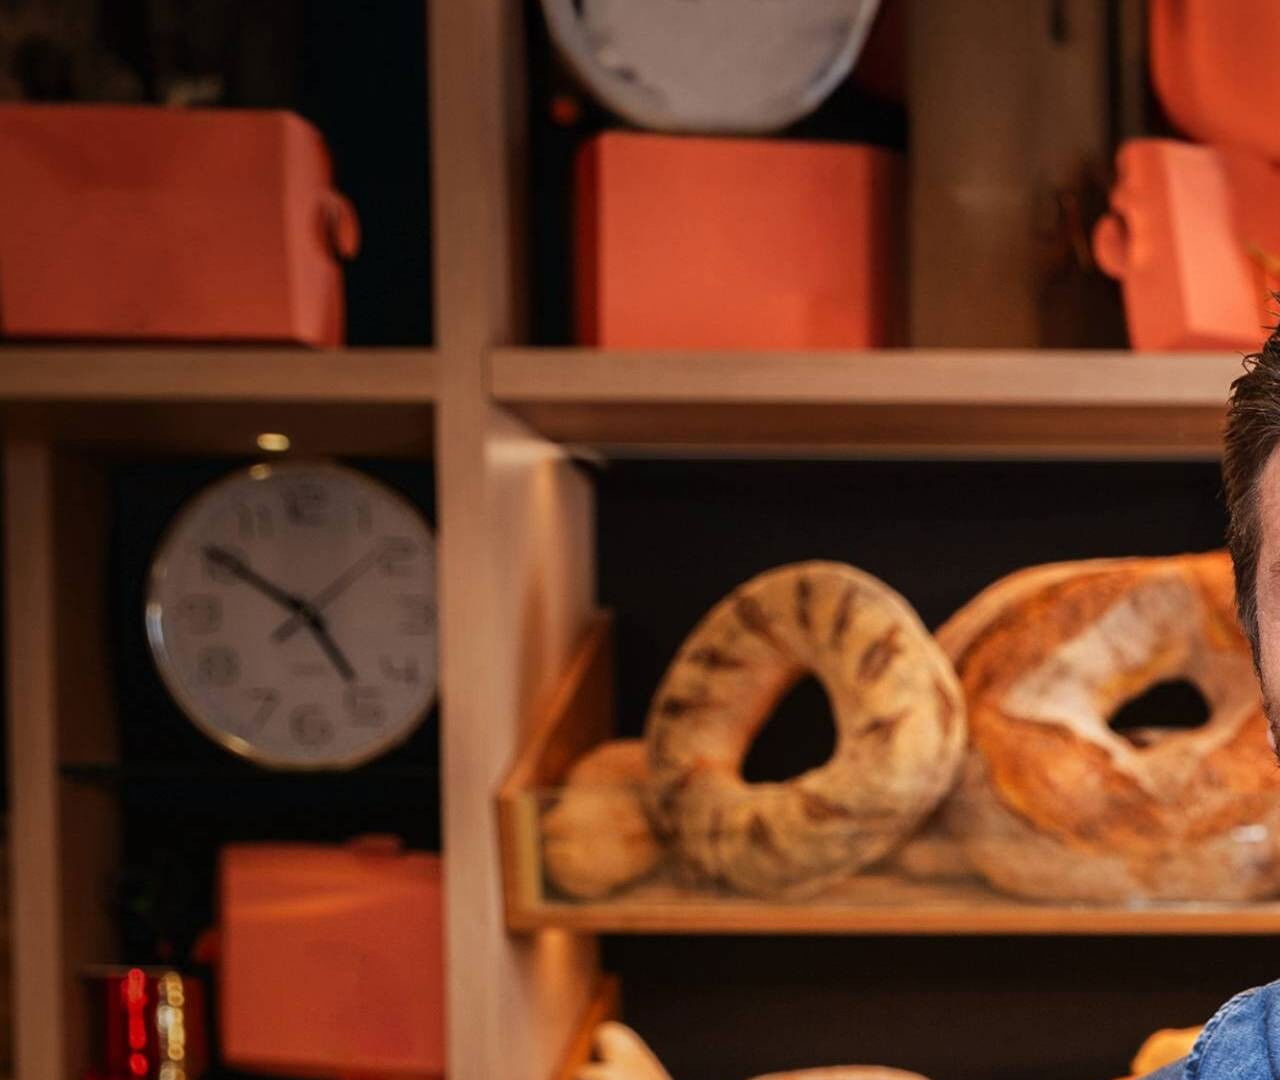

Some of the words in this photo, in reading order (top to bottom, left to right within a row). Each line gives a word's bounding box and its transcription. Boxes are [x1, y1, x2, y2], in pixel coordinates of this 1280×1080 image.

[236, 503, 274, 539] 11
[357, 502, 372, 538] 1
[380, 537, 419, 578] 2
[181, 594, 223, 635] 9
[400, 594, 437, 635] 3
[198, 645, 242, 687] 8
[380, 655, 419, 688] 4
[243, 688, 280, 735] 7
[289, 703, 334, 746] 6
[344, 686, 386, 727] 5
